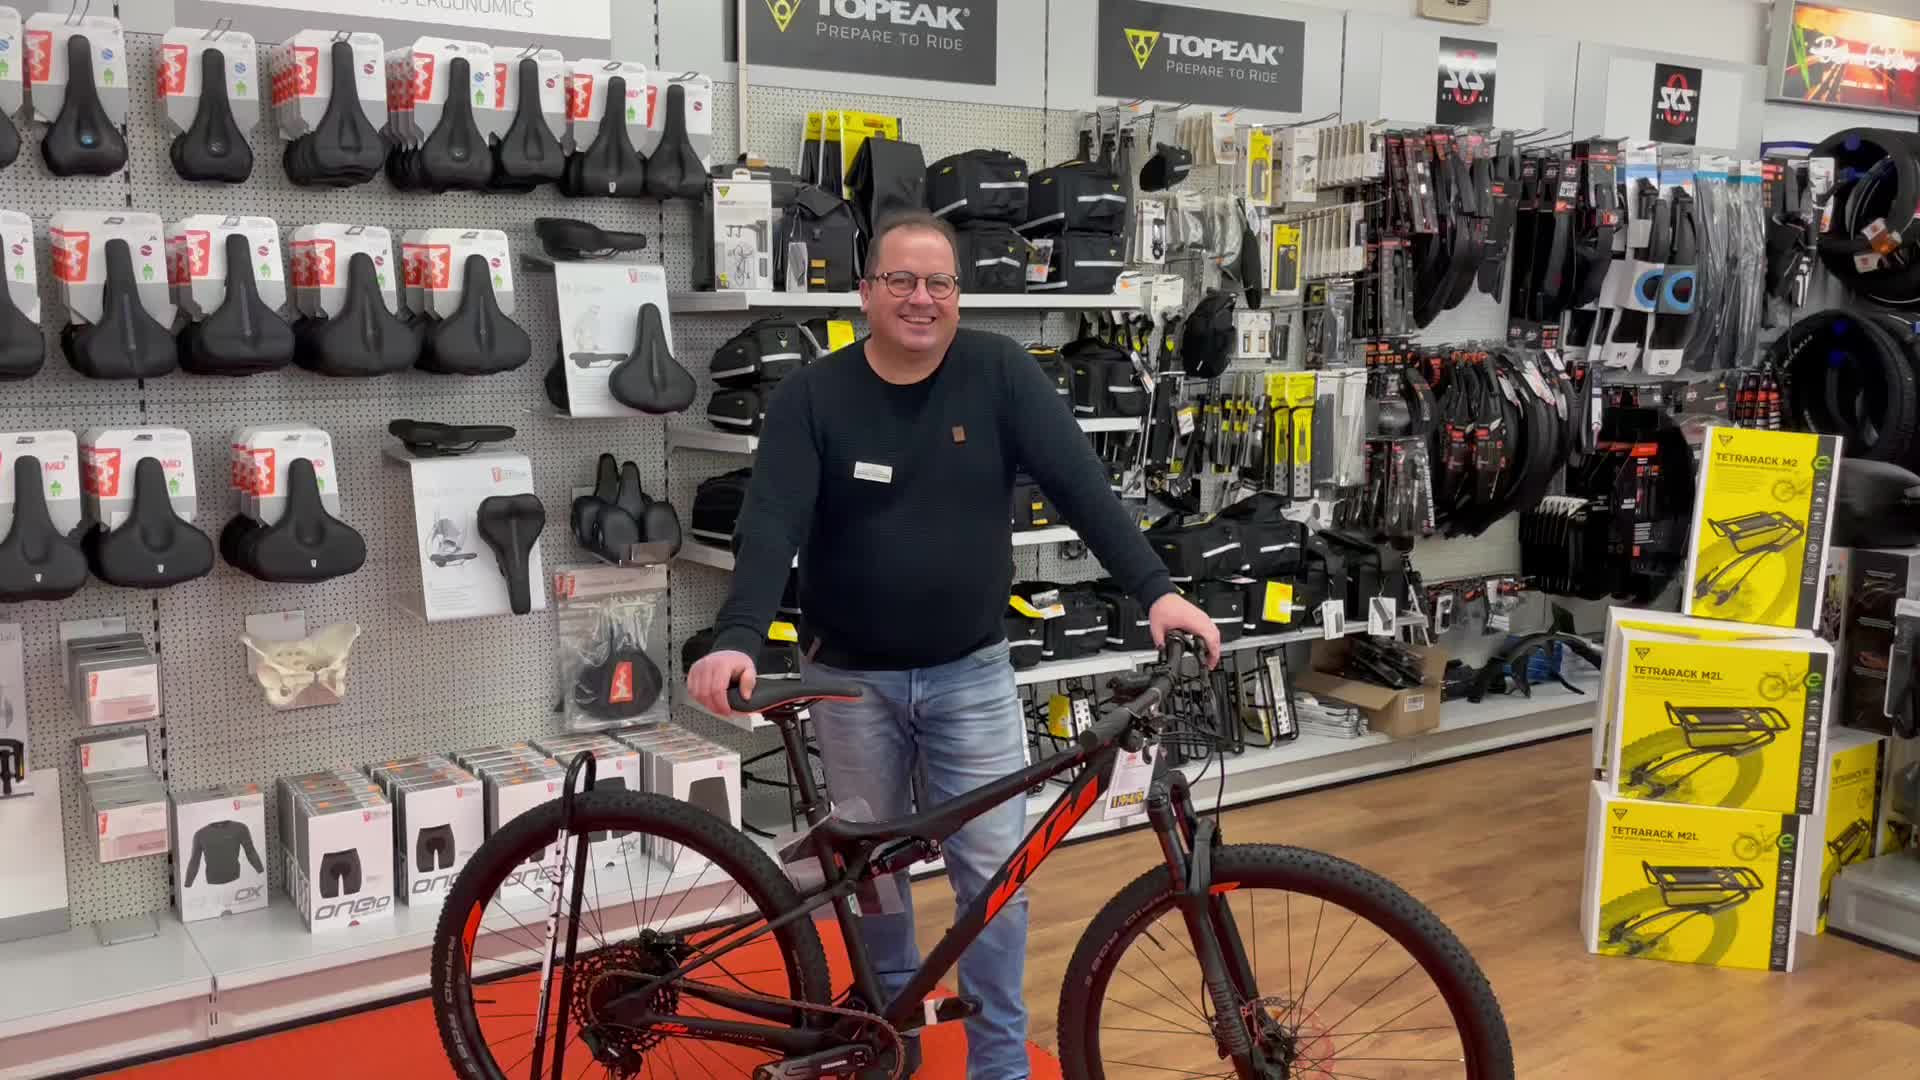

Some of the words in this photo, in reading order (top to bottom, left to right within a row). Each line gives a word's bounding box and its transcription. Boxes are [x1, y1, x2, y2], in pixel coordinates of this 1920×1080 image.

[816, 22, 893, 44] PREPARE
[900, 32, 920, 47] TO
[926, 34, 964, 51] RIDE
[1166, 60, 1224, 79] PREPARE
[1229, 68, 1245, 81] TO
[1249, 69, 1278, 84] RIDE
[1657, 86, 1696, 111] SKS
[1715, 452, 1778, 466] TETRARACK
[1782, 459, 1798, 467] M2
[1633, 665, 1698, 680] TETRARACK
[1701, 671, 1723, 681] M2L
[1612, 826, 1673, 841] TETRARACK
